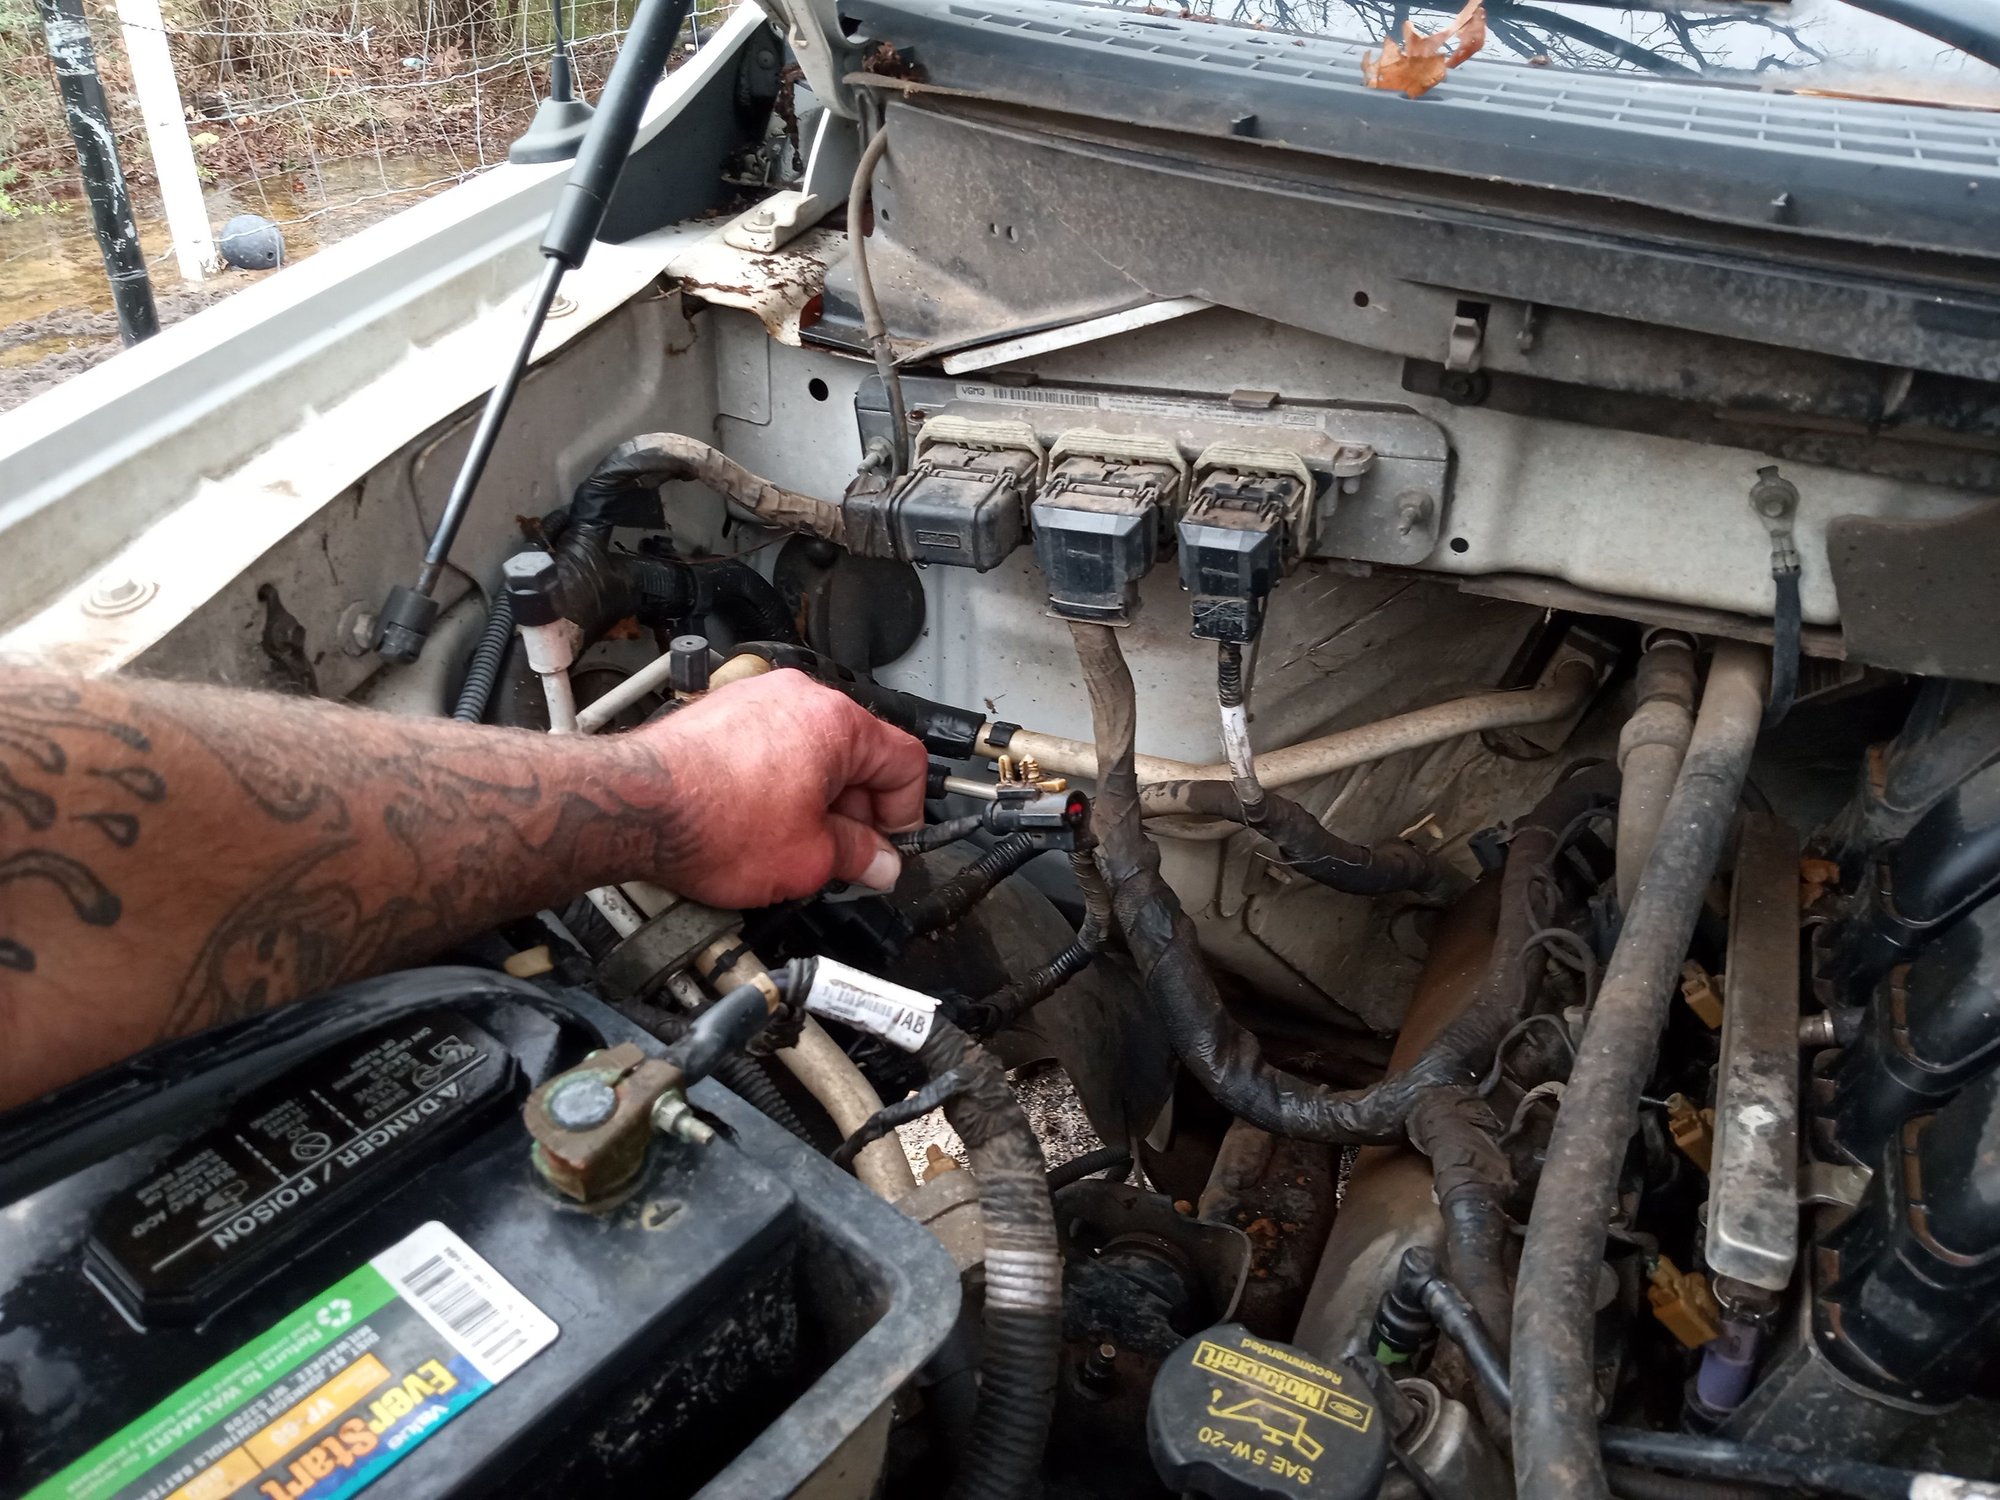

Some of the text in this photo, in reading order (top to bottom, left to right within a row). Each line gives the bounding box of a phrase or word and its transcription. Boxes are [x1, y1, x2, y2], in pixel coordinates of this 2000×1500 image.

[961, 385, 985, 395] VGM3
[210, 1096, 441, 1249] DANGER / POISON
[262, 1328, 323, 1372] Return
[1239, 1336, 1343, 1387] Recommended
[240, 1369, 263, 1386] to
[264, 1368, 327, 1417] JOHNSON
[266, 1384, 289, 1402] WI
[1202, 1344, 1323, 1408] Motorcraft
[145, 1385, 242, 1457] WALMART
[192, 1412, 267, 1468] CONTROLS
[257, 1357, 458, 1500] EverStart
[384, 1403, 449, 1450] Value
[1269, 1454, 1314, 1485] SAE
